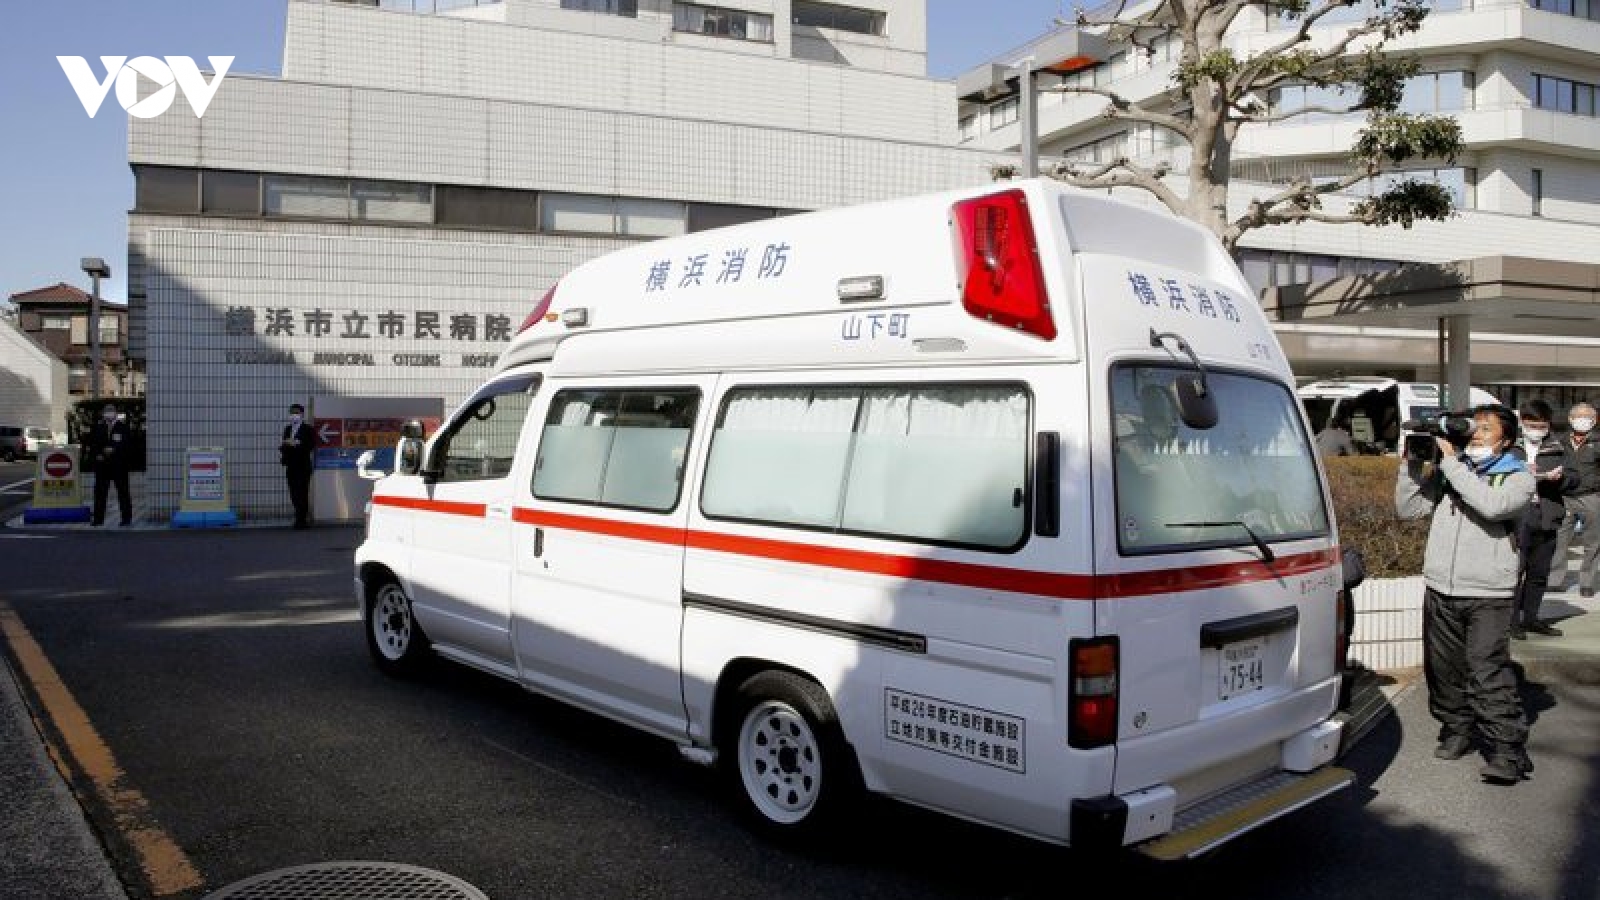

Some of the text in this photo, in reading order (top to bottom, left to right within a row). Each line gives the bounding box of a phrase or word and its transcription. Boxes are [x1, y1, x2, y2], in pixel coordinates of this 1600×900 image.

[646, 241, 792, 292] 横浜消防
[1127, 270, 1240, 323] 横浜消防
[225, 305, 512, 343] 横浜市立市民病院
[842, 313, 911, 341] 山下町
